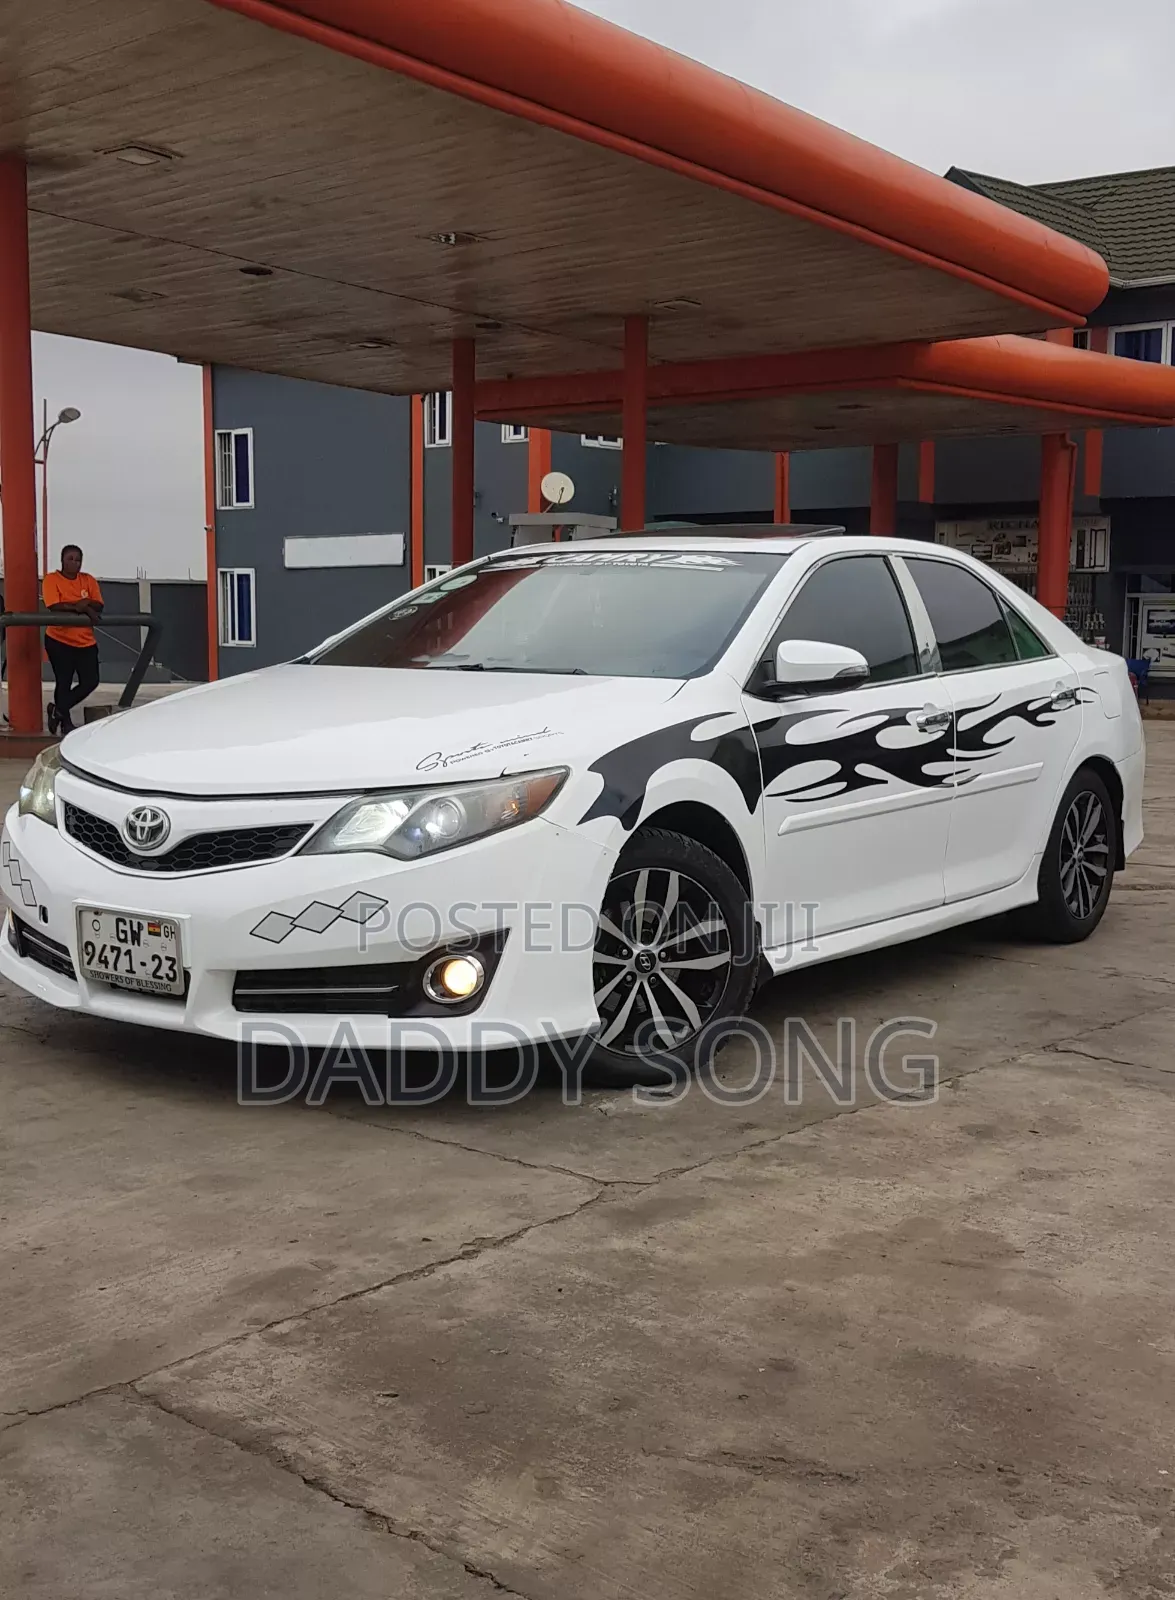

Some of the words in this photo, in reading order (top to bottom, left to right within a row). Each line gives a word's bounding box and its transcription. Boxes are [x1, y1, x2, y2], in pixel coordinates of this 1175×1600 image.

[542, 552, 676, 563] CAMRY
[115, 917, 142, 947] GW
[84, 940, 177, 982] 9471-23
[89, 970, 124, 985] SHOWERS
[124, 976, 135, 985] OF
[136, 979, 172, 992] BLESSING
